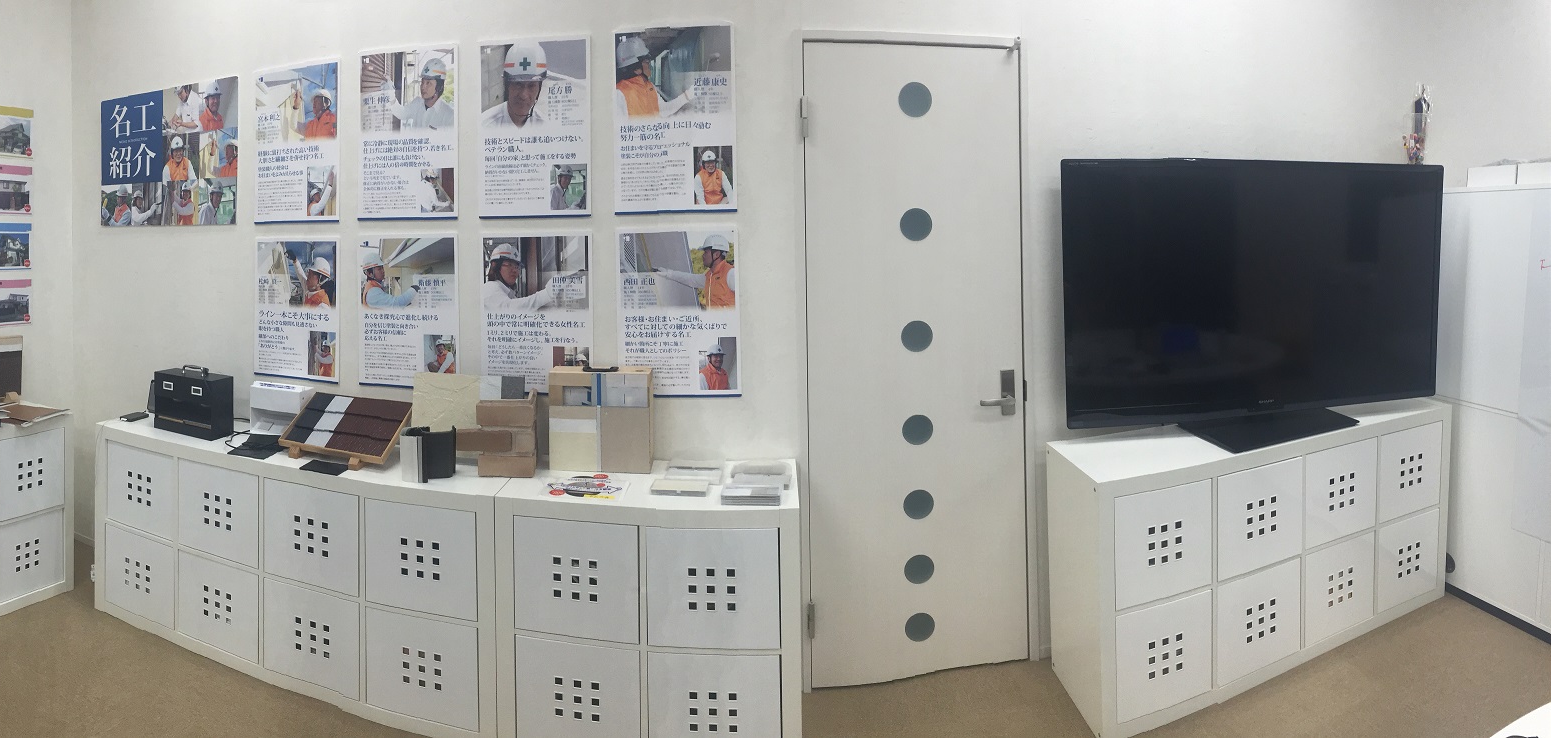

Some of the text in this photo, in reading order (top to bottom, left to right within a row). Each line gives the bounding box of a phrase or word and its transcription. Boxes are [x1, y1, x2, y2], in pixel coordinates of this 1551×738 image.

[109, 101, 157, 138] 名工
[484, 134, 584, 146] 技術とスピードは誰も追いつけない。
[484, 145, 524, 153] ベテラン職人。
[109, 143, 157, 179] 紹介
[640, 277, 656, 286] 正也
[258, 310, 330, 322] ライン一本こそ大事にする
[487, 313, 546, 321] 仕上がりのイメージを
[487, 321, 586, 329] 頭の中で常に明確化できる女性名工
[624, 323, 728, 331] すべてに対しての細かな気くばりで
[624, 331, 692, 339] 安心をお届けする名工
